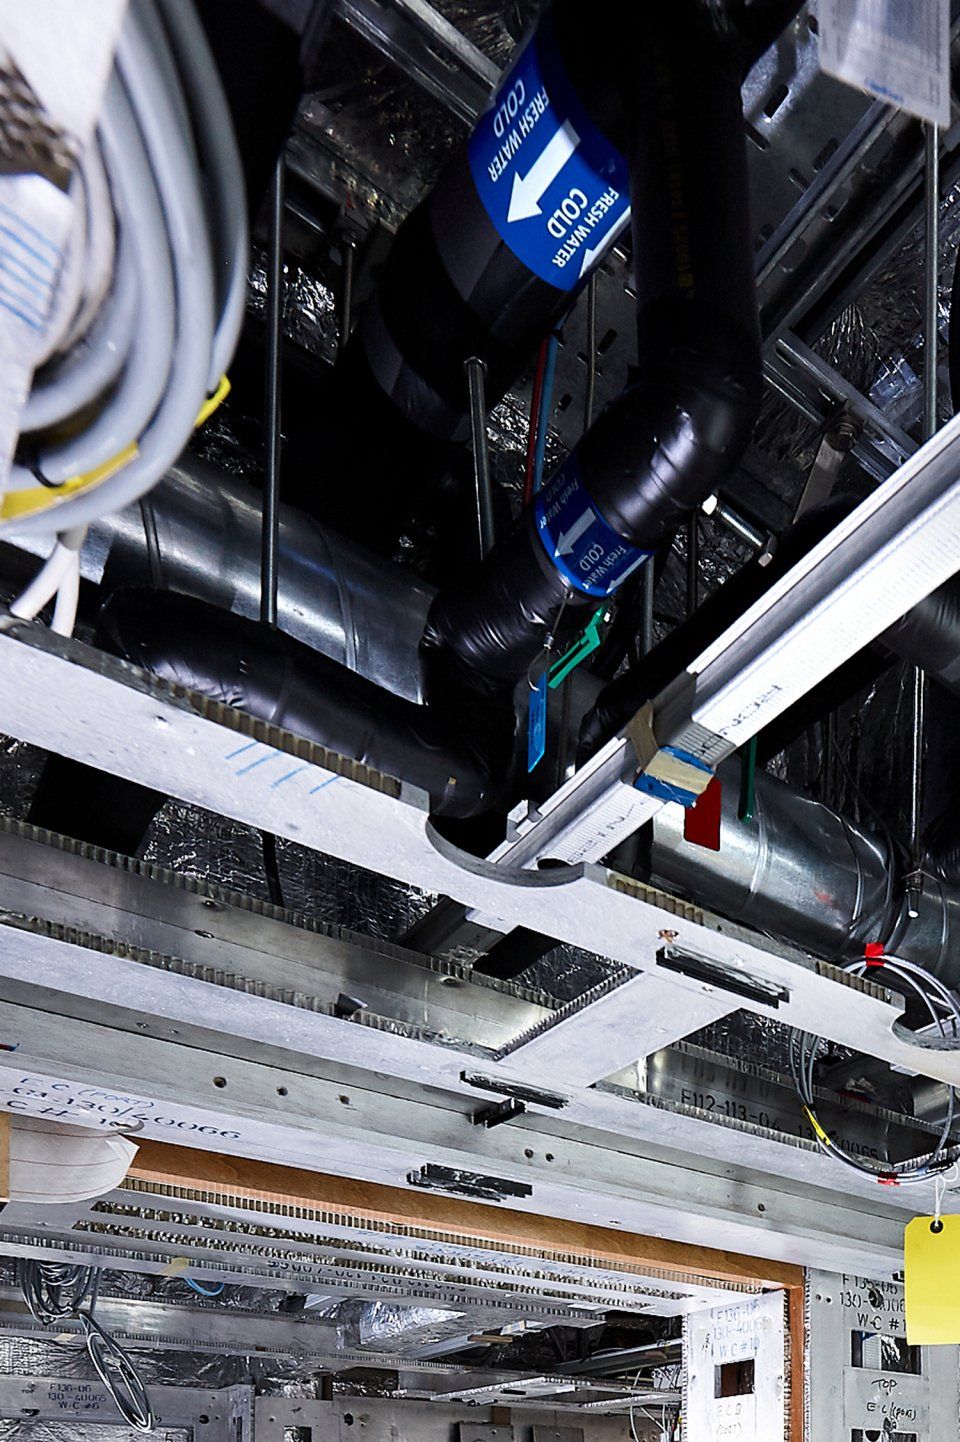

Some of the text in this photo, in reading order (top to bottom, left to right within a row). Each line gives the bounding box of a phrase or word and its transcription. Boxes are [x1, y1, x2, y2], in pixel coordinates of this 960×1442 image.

[487, 85, 550, 182] FRESH WATER
[493, 79, 526, 138] COLD
[547, 188, 589, 239] COLD
[551, 186, 620, 268] FRESH WATER
[580, 543, 604, 571] COLD
[603, 545, 627, 567] Fresh
[871, 1378, 898, 1393] TOP
